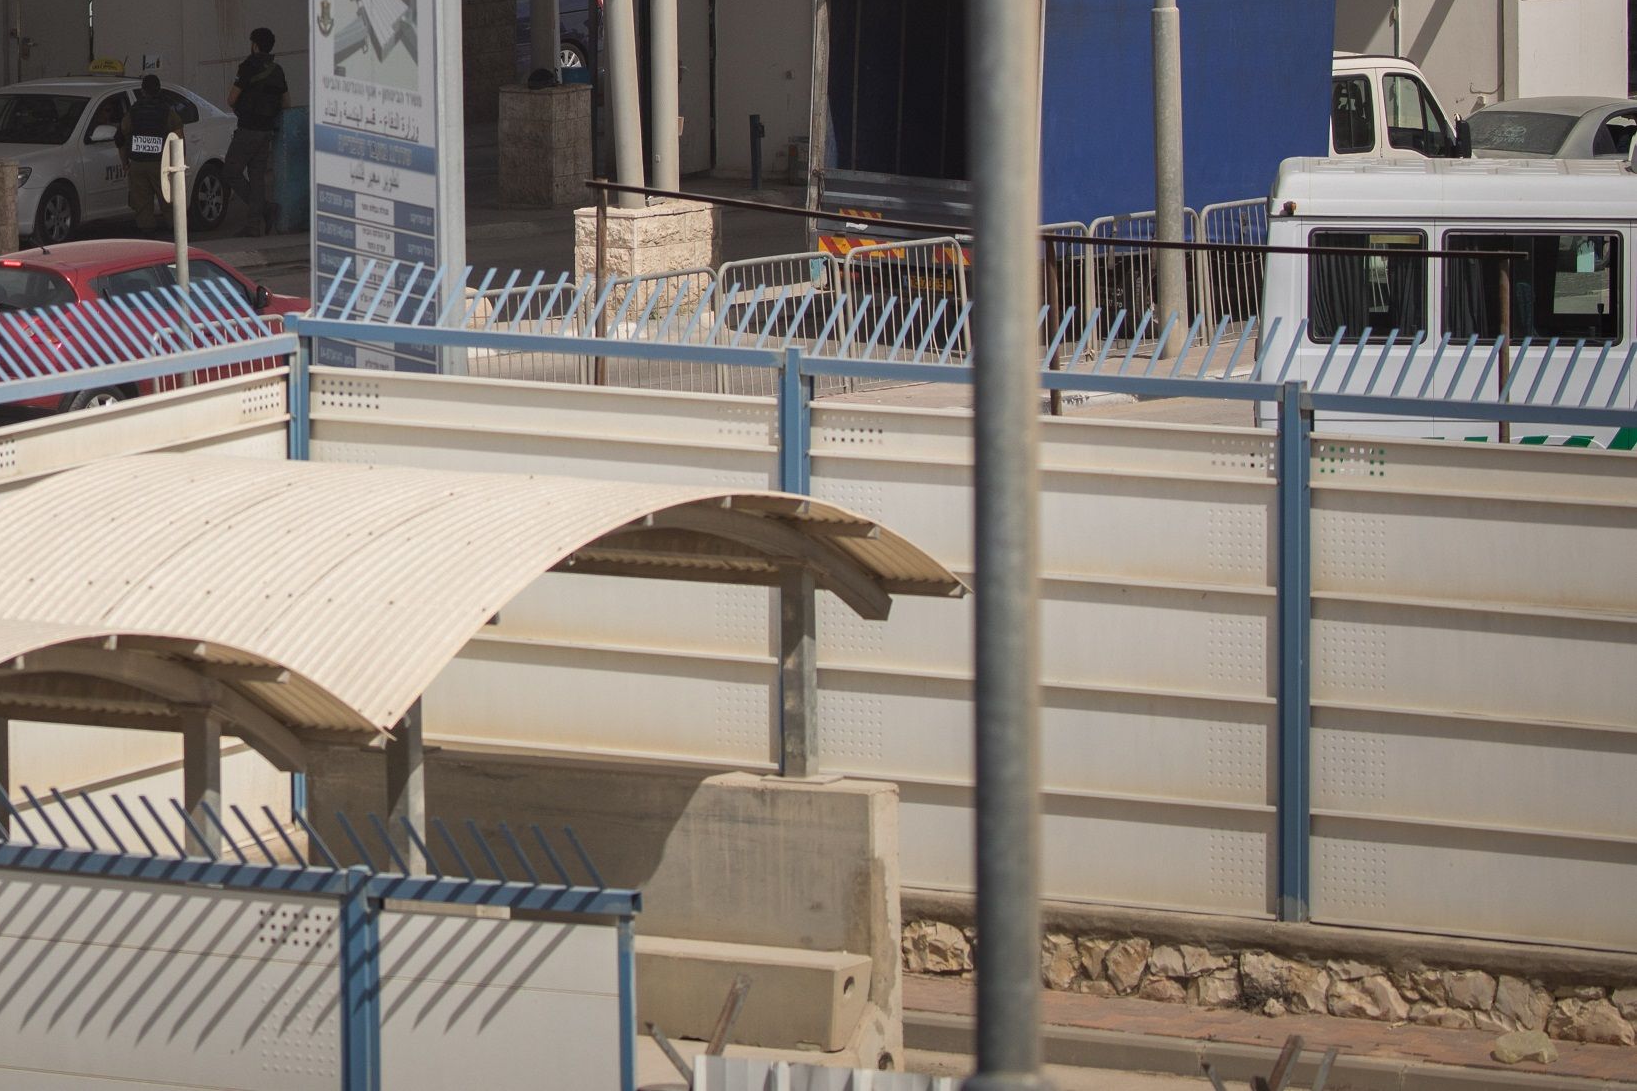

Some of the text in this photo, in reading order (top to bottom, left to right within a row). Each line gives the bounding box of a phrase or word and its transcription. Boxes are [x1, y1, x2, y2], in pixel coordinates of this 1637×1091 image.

[133, 135, 162, 145] המשטרה
[134, 144, 160, 152] הצבאית
[105, 164, 126, 181] ונית
